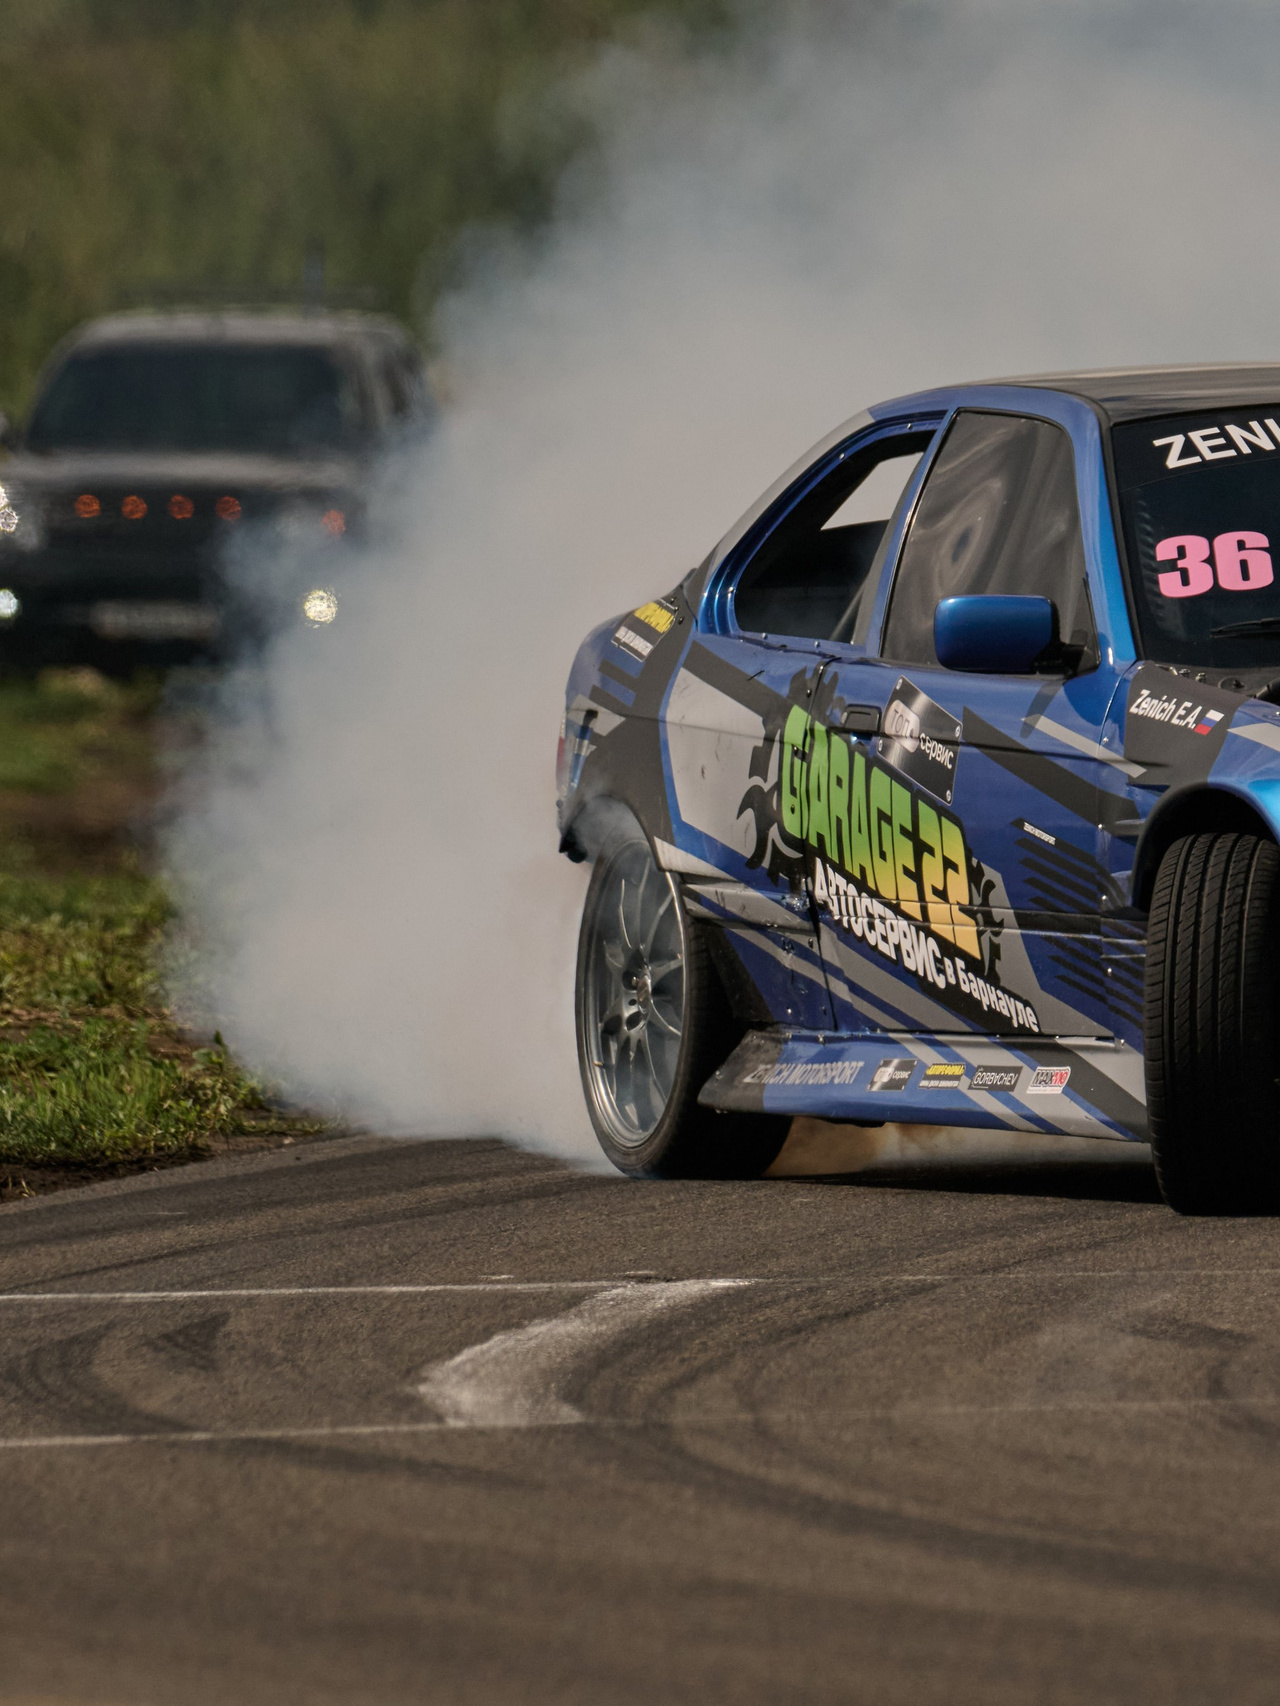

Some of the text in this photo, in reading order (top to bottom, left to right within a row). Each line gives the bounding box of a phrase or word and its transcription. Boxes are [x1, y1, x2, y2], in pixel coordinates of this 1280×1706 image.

[1155, 530, 1274, 598] 36
[1129, 689, 1177, 722] Zenich
[919, 732, 954, 769] сервис
[814, 856, 1040, 1033] АВТОСЕРВИС в Барнауле
[785, 1061, 865, 1084] MOTORSPORT
